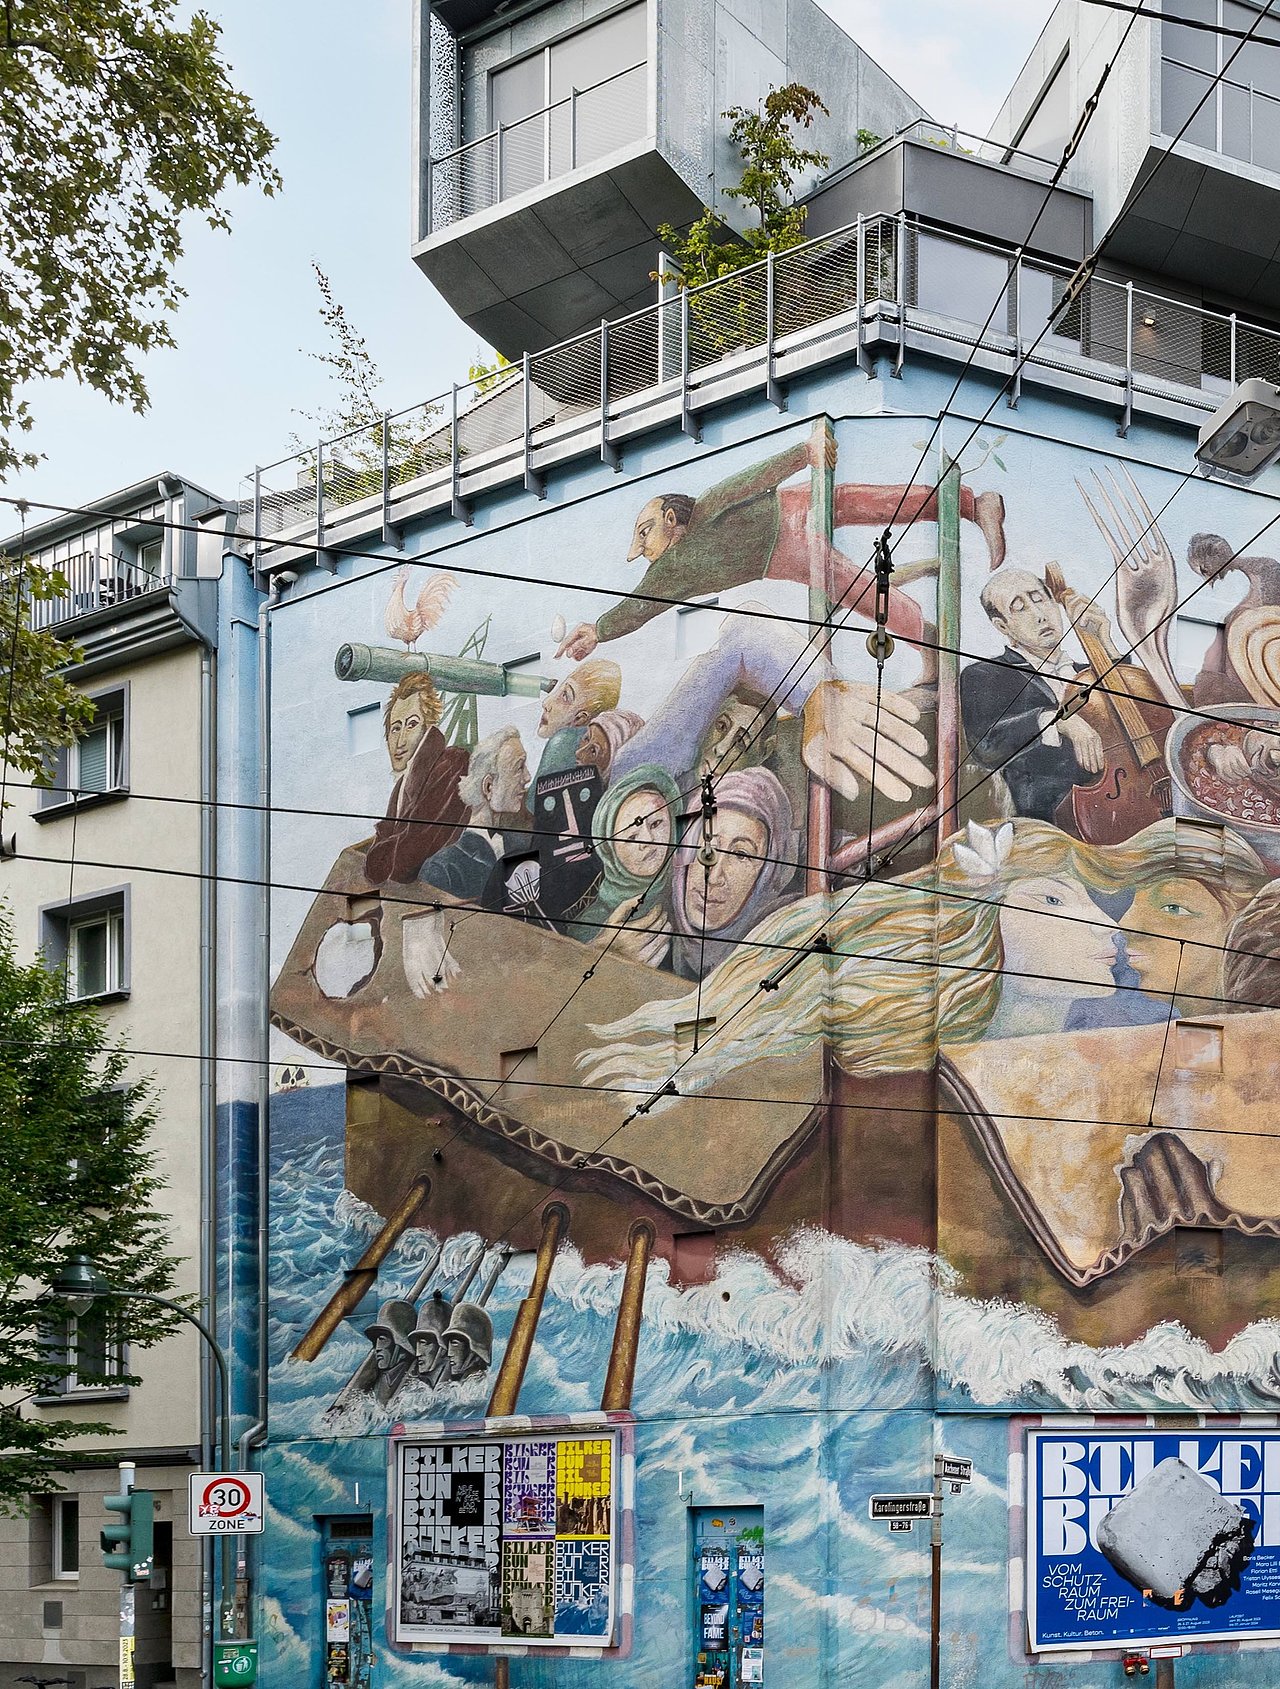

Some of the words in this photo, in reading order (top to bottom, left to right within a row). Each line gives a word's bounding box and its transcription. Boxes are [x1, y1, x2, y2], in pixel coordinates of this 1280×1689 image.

[557, 1440, 610, 1456] BILKER
[404, 1446, 501, 1473] BILKER
[404, 1474, 452, 1499] BUN
[484, 1473, 501, 1498] R
[213, 1489, 240, 1507] 30
[403, 1500, 451, 1525] BIL
[484, 1500, 500, 1525] R
[873, 1500, 927, 1514] Karolingerstraße
[209, 1519, 245, 1530] ZONE
[503, 1541, 554, 1555] BILKER
[556, 1541, 609, 1555] BILKER
[503, 1555, 528, 1568] BUN
[503, 1568, 528, 1582] BIL
[1048, 1563, 1082, 1576] VOM
[1042, 1574, 1107, 1588] SCHUTZ-
[1058, 1586, 1100, 1599] RAUM
[1064, 1597, 1096, 1610] ZUM
[1100, 1596, 1135, 1609] FREI-
[703, 1613, 724, 1625] BEYOND
[1077, 1608, 1119, 1621] RAUM
[703, 1628, 724, 1638] FAME
